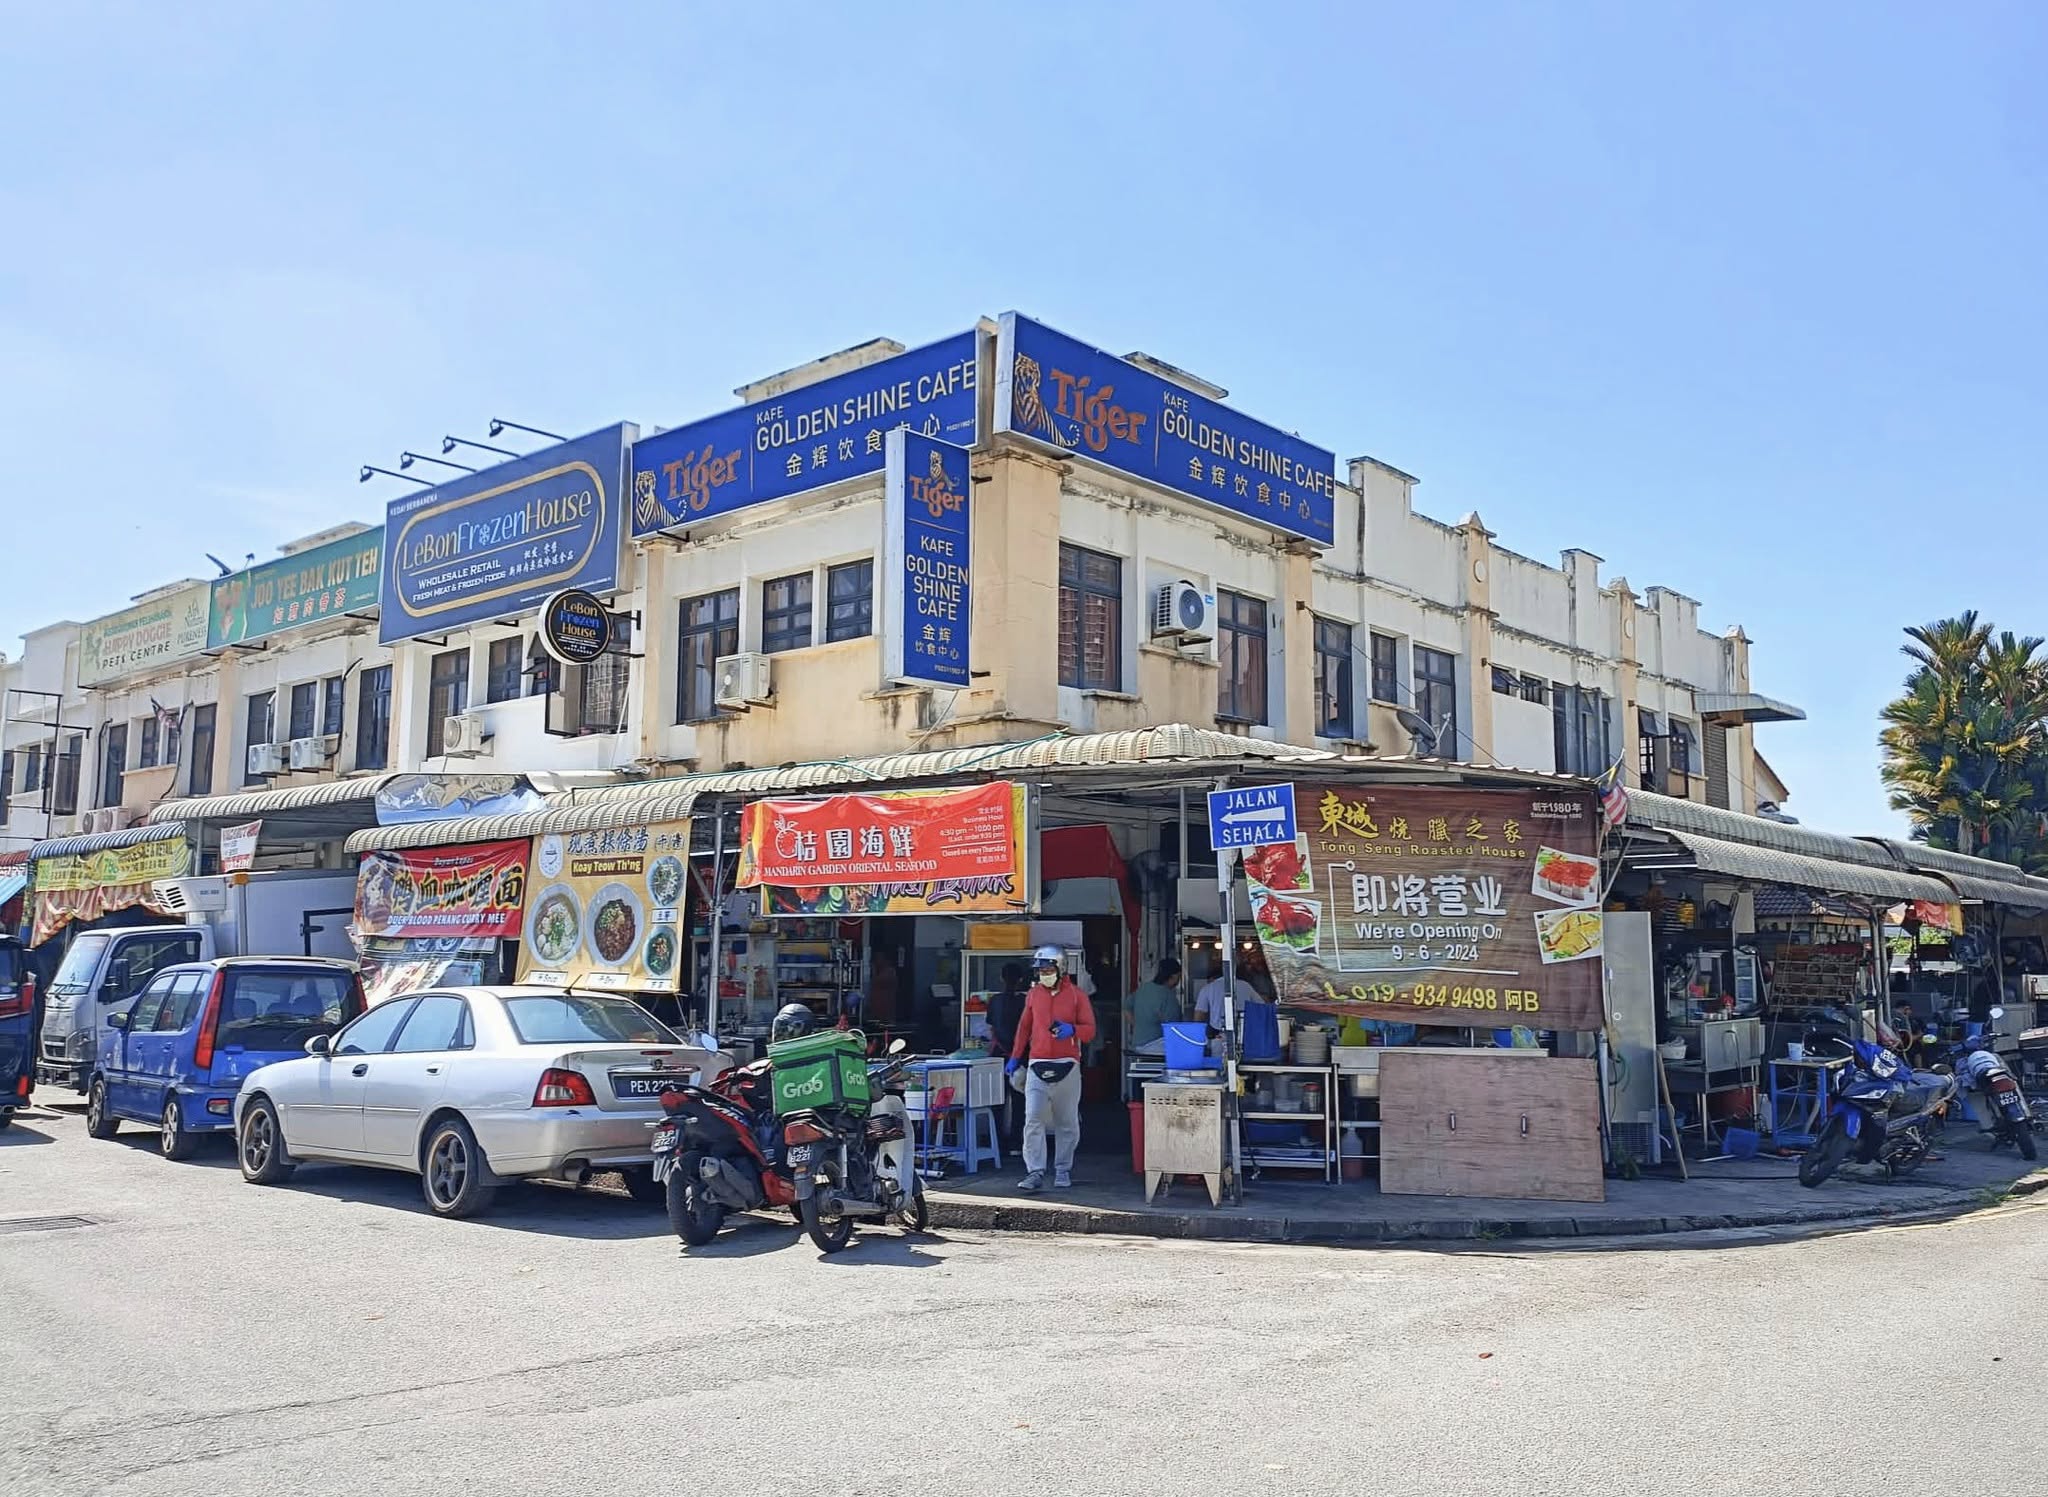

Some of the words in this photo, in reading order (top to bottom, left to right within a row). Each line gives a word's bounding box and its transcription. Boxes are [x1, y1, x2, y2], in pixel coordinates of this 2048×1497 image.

[755, 405, 784, 424] KAFE
[1050, 368, 1147, 452] Tiger
[1162, 390, 1189, 414] KAFE
[756, 404, 838, 451] GOLDEN
[843, 382, 912, 426] SHINE
[1162, 409, 1236, 461] GOLDEN
[1239, 441, 1292, 482] SHINE
[662, 444, 742, 512] Tiger
[1188, 457, 1311, 520] 金辉饮食中心
[908, 473, 965, 518] Tiger
[920, 535, 954, 558] KAFE
[277, 572, 298, 602] YEE
[300, 563, 325, 596] BAK
[328, 555, 354, 587] KUT
[354, 546, 379, 578] TEH
[418, 567, 469, 590] WHOLESALE
[470, 559, 501, 576] RETAIL
[905, 553, 968, 586] GOLDEN
[913, 575, 962, 602] SHINE
[563, 599, 598, 617] LeBon
[917, 596, 957, 621] CAFE
[136, 621, 173, 646] DOGGIE
[562, 621, 596, 638] House
[102, 655, 125, 669] PETS
[130, 641, 171, 662] CENTRE
[1226, 790, 1278, 809] JALAN
[1222, 822, 1286, 844] SEHALA
[1319, 841, 1356, 855] Tong
[1364, 842, 1402, 856] Seng
[1410, 844, 1474, 856] Roasted
[1481, 846, 1526, 858] House
[573, 862, 593, 874] Koay
[594, 861, 615, 872] Teow
[617, 859, 641, 872] Th'ng
[764, 866, 807, 877] MANDARIN
[807, 863, 849, 876] GARDEN
[849, 861, 892, 874] ORIENTAL
[895, 860, 937, 872] SEAFOOD
[1352, 873, 1507, 917] 即将营业
[387, 915, 407, 925] DUCK
[408, 914, 433, 925] BLOOD
[433, 913, 462, 925] PENANG
[462, 913, 486, 924] CURRY
[487, 912, 506, 923] MEE
[1355, 923, 1405, 939] We're
[1410, 922, 1479, 942] Opening
[1482, 923, 1503, 940] On
[1392, 945, 1404, 960] 9
[1419, 944, 1430, 960] 6
[1445, 944, 1479, 960] 2024
[1351, 983, 1396, 1002] 019
[1413, 983, 1447, 1006] 934
[1451, 985, 1498, 1010] 9498
[1504, 989, 1540, 1012] 阿B
[630, 1080, 651, 1093] PEX
[782, 1073, 824, 1098] Grab
[846, 1069, 866, 1086] Grab
